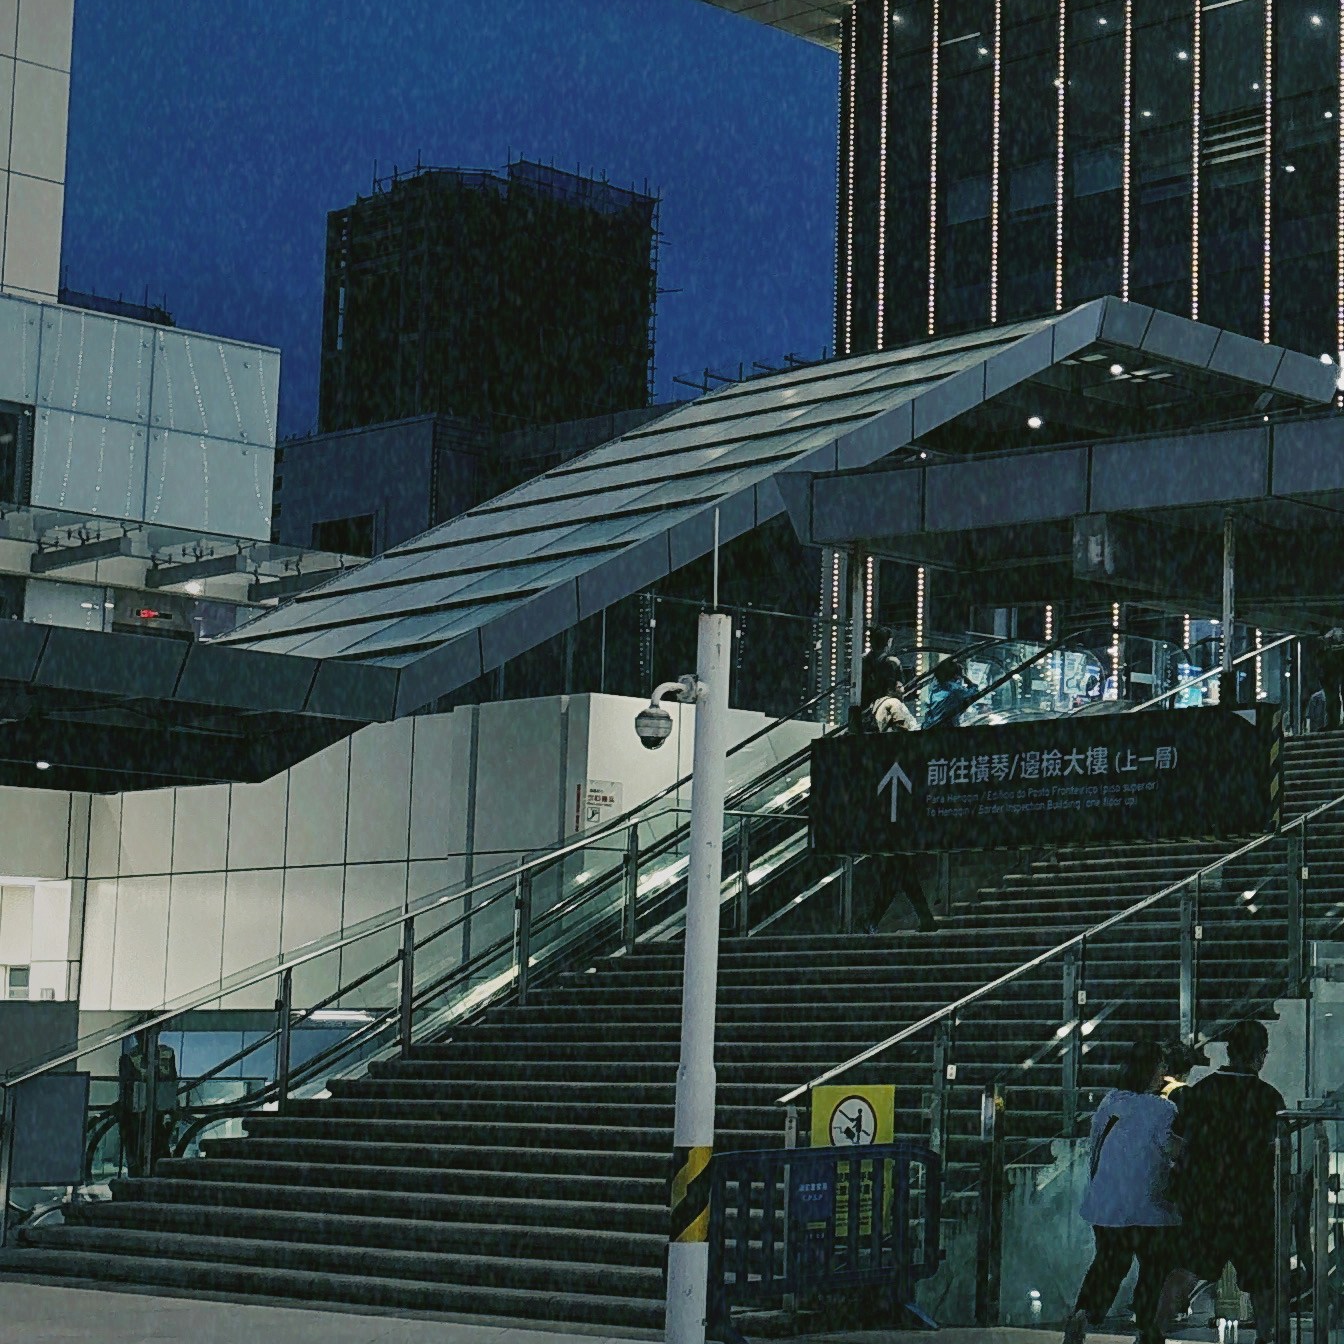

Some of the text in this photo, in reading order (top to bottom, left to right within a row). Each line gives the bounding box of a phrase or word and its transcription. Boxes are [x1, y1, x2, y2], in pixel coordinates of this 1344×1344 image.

[926, 745, 1179, 787] 前往橫琴/邊檢大樓 (上一層)
